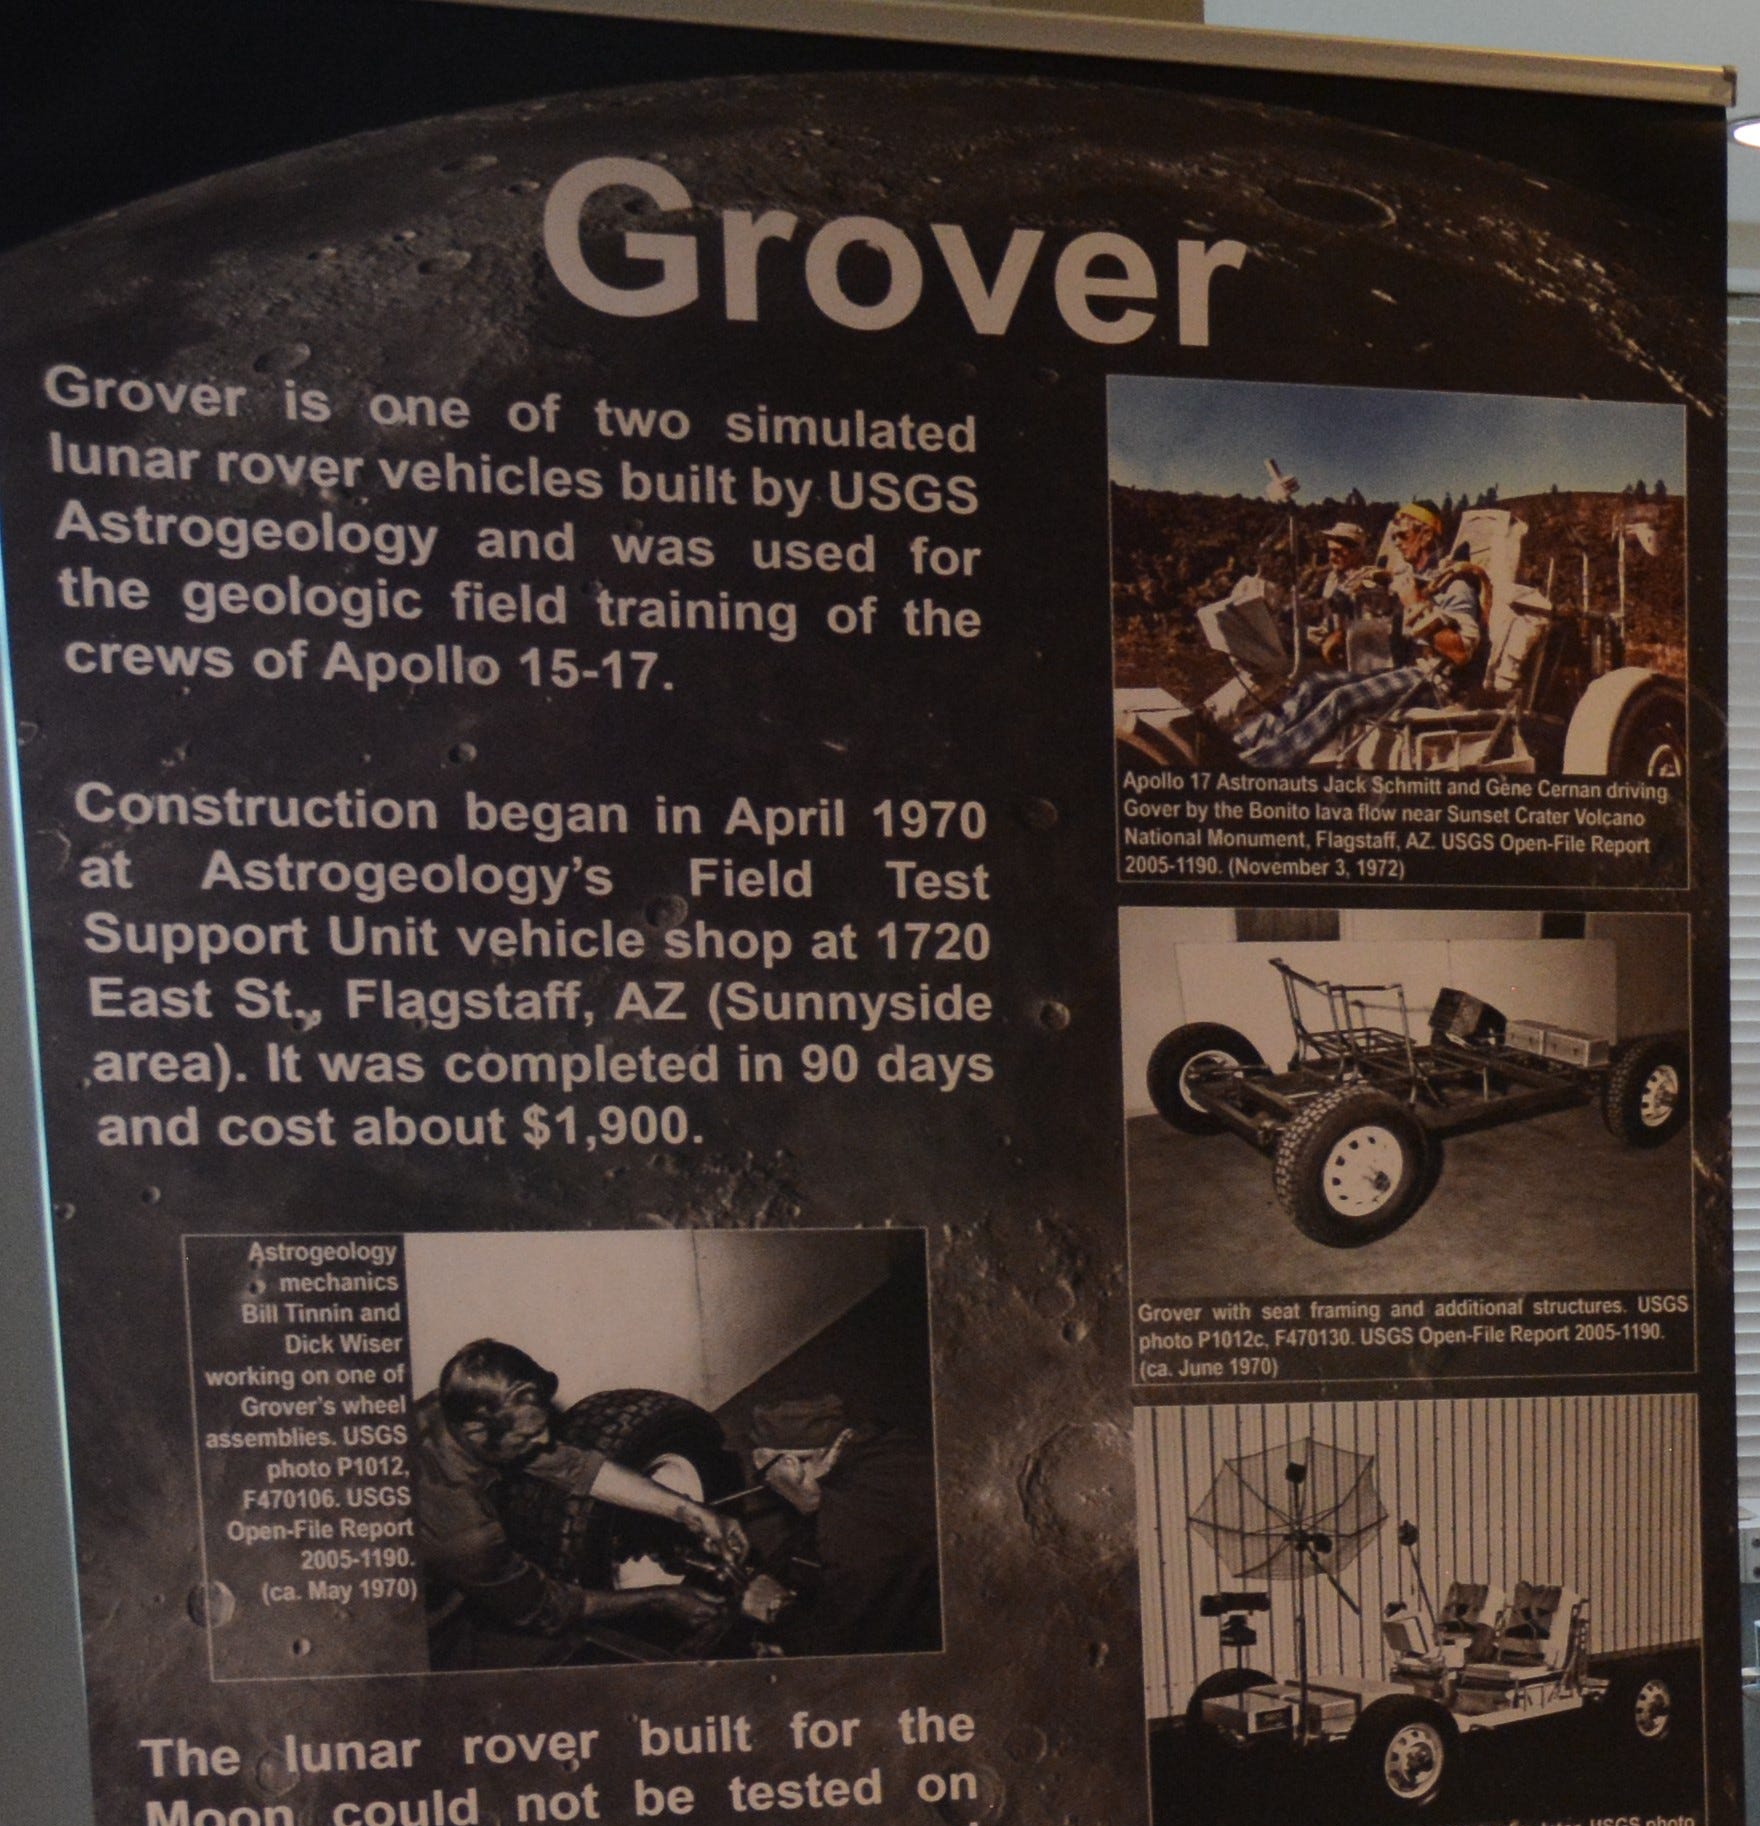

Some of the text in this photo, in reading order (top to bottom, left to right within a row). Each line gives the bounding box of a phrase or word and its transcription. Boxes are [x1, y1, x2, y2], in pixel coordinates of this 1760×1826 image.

[540, 156, 1247, 347] Grover
[43, 363, 976, 453] Grover is one of two simulated
[54, 499, 981, 576] Astrogeology and was used for
[64, 638, 673, 692] crews of Apollo 15-17.
[1122, 770, 1668, 804] Apollo 17 Astronauts Jack Schmitt and Gene Cernan driving
[74, 781, 986, 845] Construction began in April 1970
[1124, 826, 1650, 857] National Monument, Flagstaff, AZ. USGS Open-File Report
[84, 910, 990, 969] Support Unit vehicle shop at 1720
[97, 1103, 703, 1151] and cost about $1,900.
[247, 1240, 397, 1268] Astrogeology
[279, 1270, 399, 1292] mechanics
[240, 1301, 400, 1324] Bill Tinnin and
[1137, 1294, 1689, 1323] Grover with seat framing and additional structures. USGS
[284, 1332, 403, 1354] Dick Wiser
[138, 1706, 975, 1778] The lunar rover built for the
[516, 1783, 600, 1822] not
[634, 1778, 694, 1816] be
[728, 1767, 882, 1812] tested
[916, 1771, 977, 1802] on
